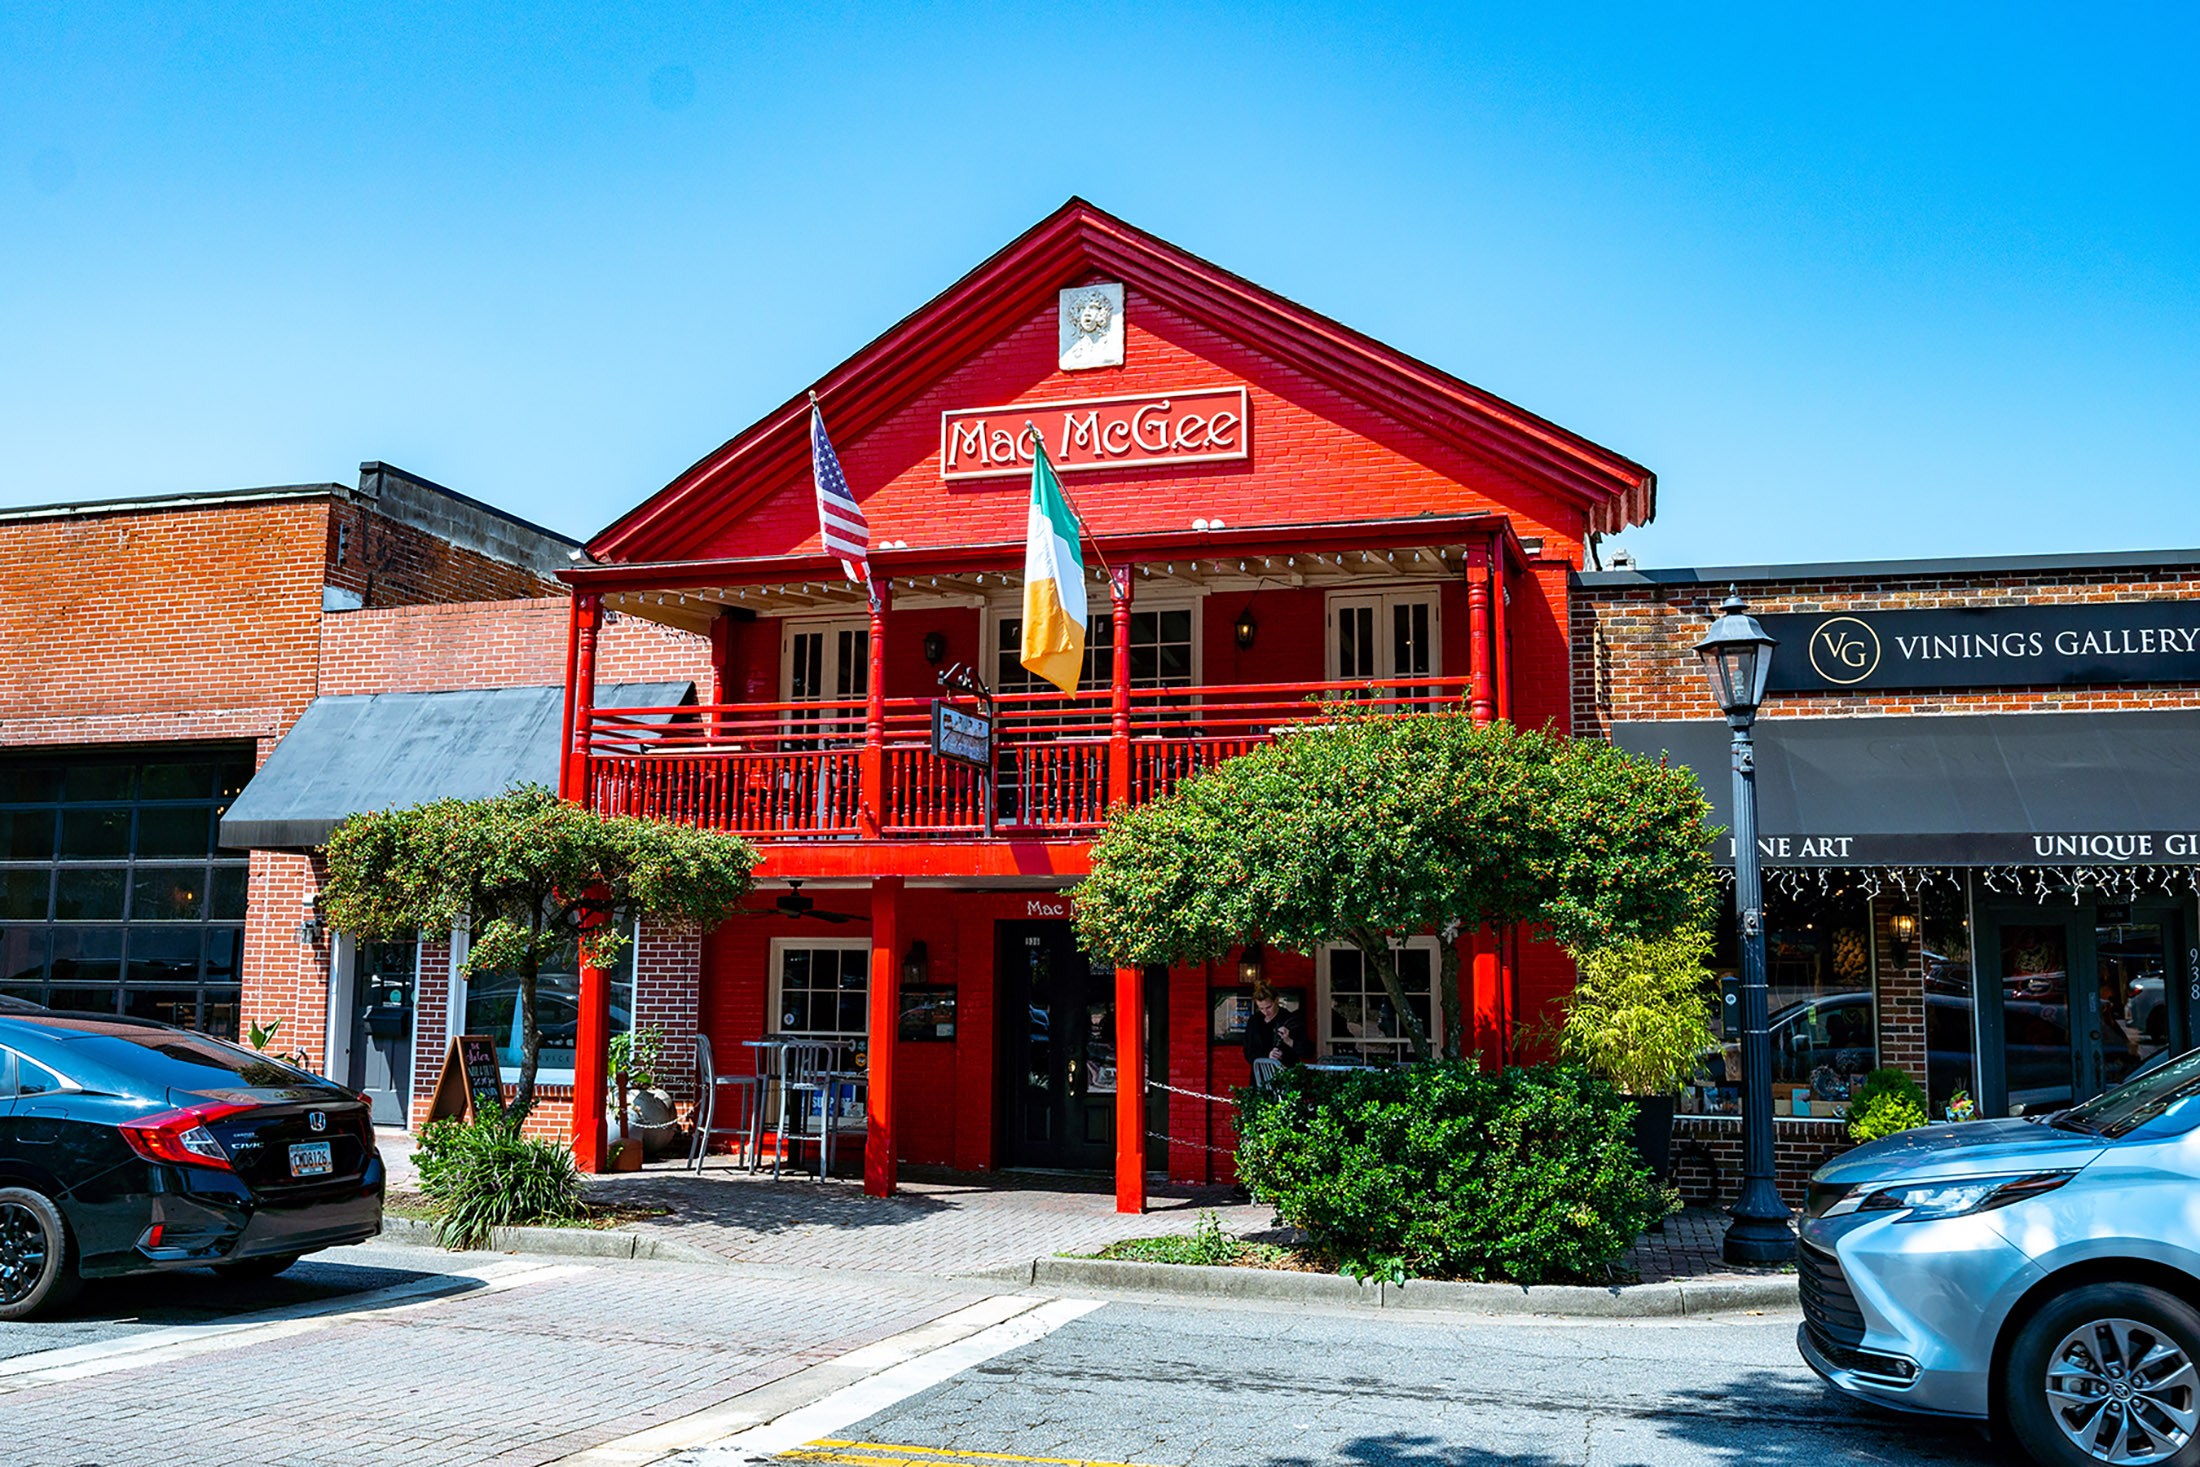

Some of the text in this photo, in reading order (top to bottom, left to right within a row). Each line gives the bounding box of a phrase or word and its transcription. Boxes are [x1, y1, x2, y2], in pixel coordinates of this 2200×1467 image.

[947, 400, 1240, 467] Mac McGee
[1895, 627, 2200, 660] VININGS GALLERY
[1729, 837, 1853, 858] NE ART
[2033, 834, 2200, 861] UNIQUE GI
[1027, 900, 1064, 916] Mac
[2189, 947, 2200, 1000] 938
[231, 1142, 265, 1150] CIVIC
